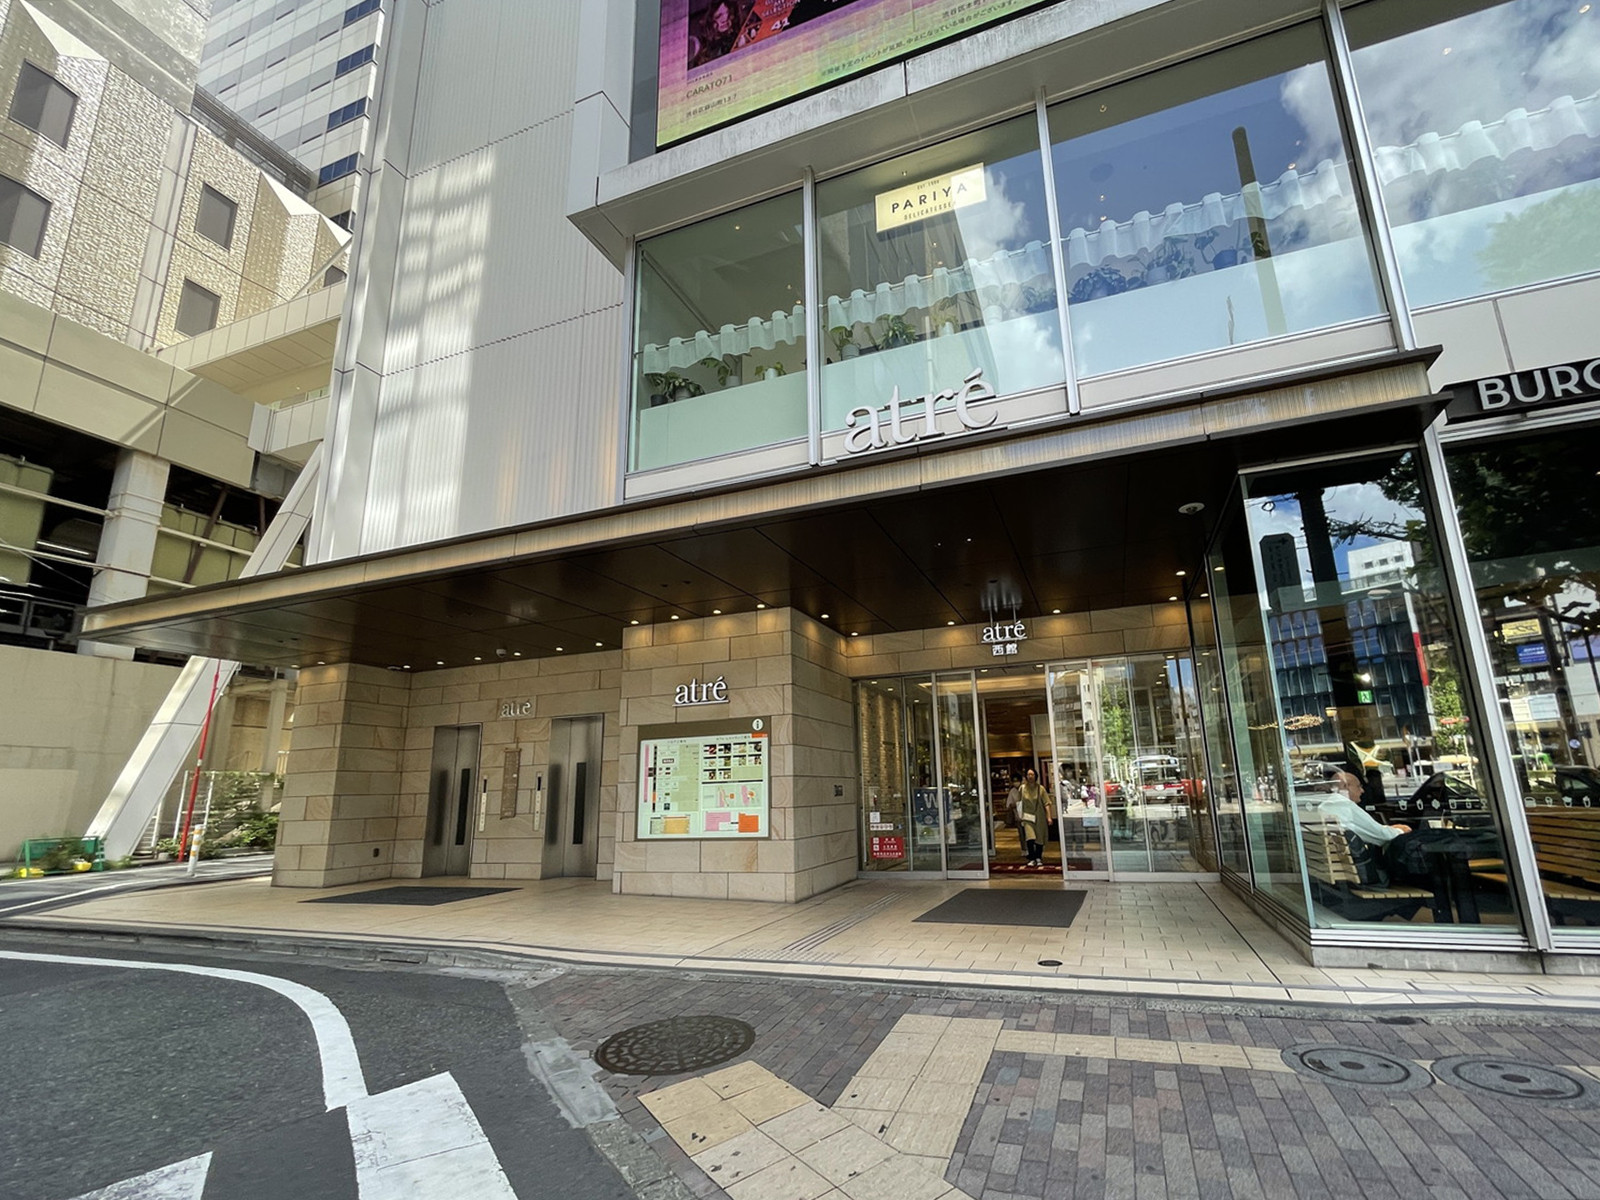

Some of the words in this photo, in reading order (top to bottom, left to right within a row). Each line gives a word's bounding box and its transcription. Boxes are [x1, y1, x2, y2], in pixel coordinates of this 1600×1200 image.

[891, 182, 968, 213] PARIYA
[844, 367, 999, 454] atré
[982, 620, 1027, 642] atré
[674, 675, 729, 705] atré
